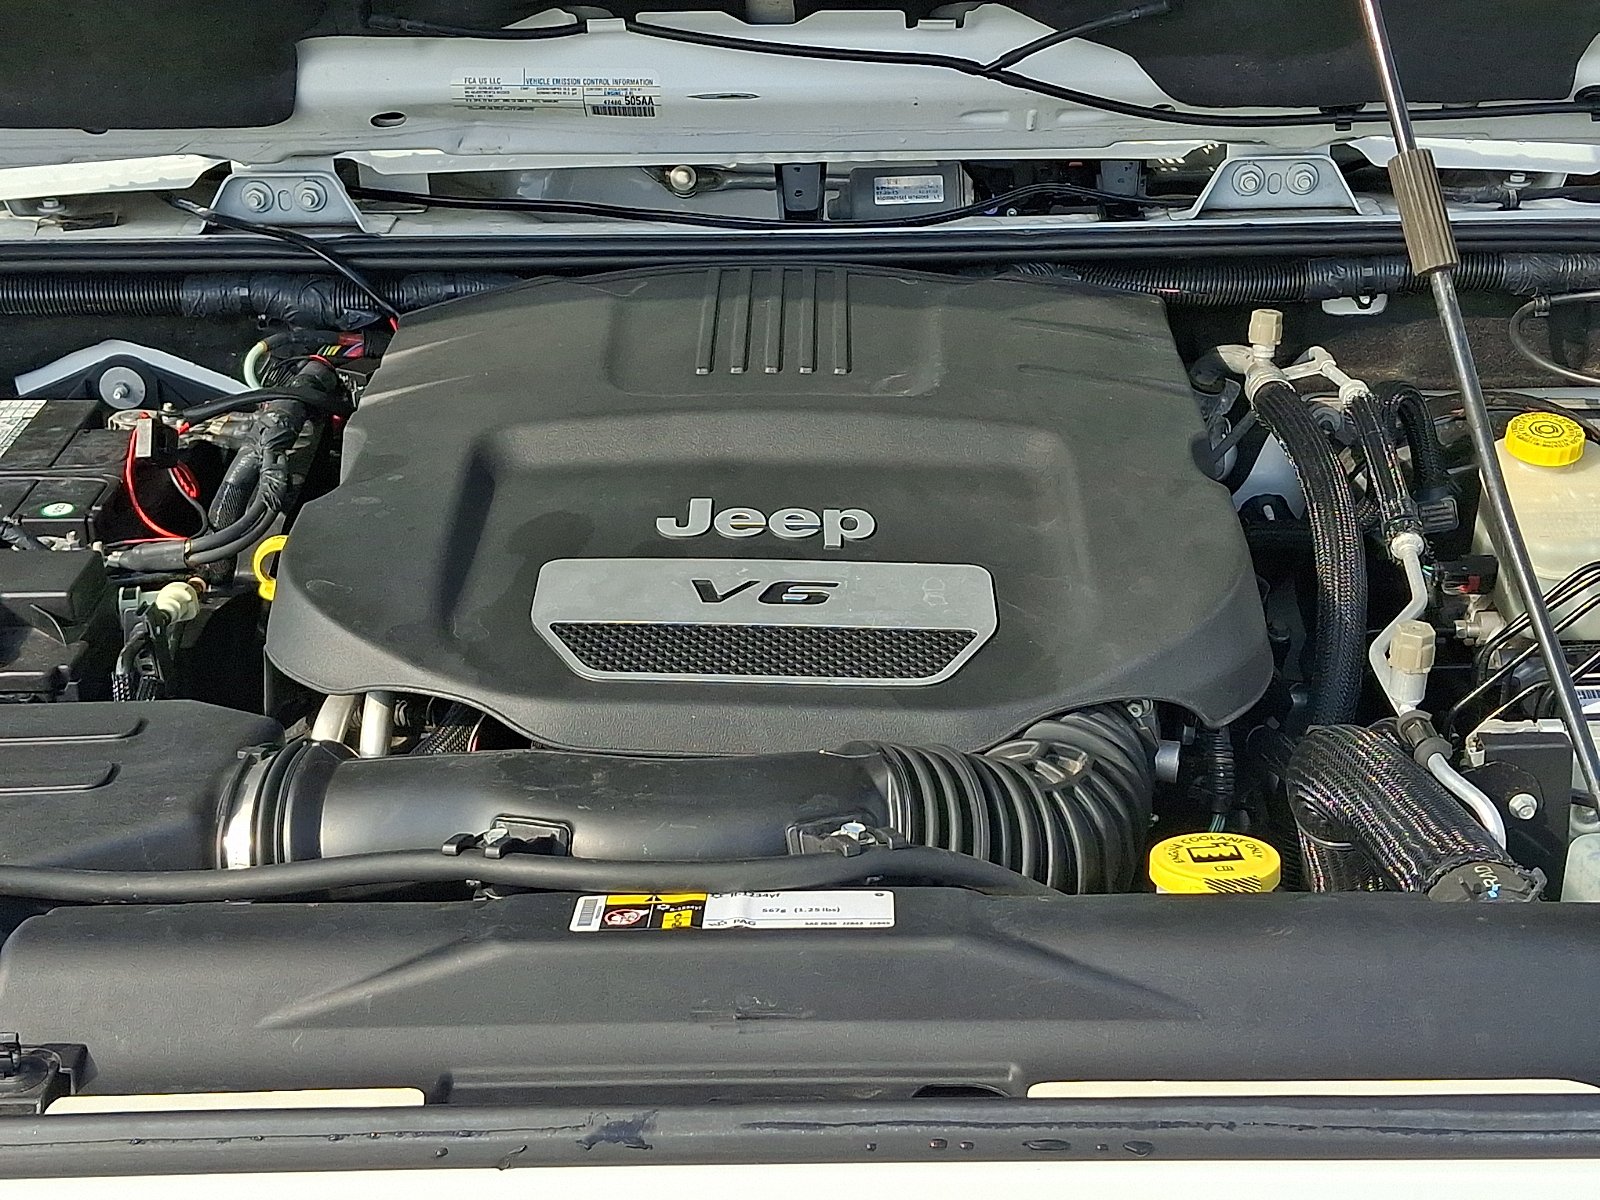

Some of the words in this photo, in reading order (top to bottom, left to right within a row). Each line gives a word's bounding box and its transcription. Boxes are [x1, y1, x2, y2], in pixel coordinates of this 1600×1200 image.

[489, 77, 502, 85] LLC
[582, 78, 610, 86] CONTROL
[612, 78, 654, 86] INFORMATION
[624, 95, 655, 106] 505AA
[656, 497, 877, 550] Jeep
[691, 578, 841, 606] V6
[1180, 835, 1246, 845] COOLANT
